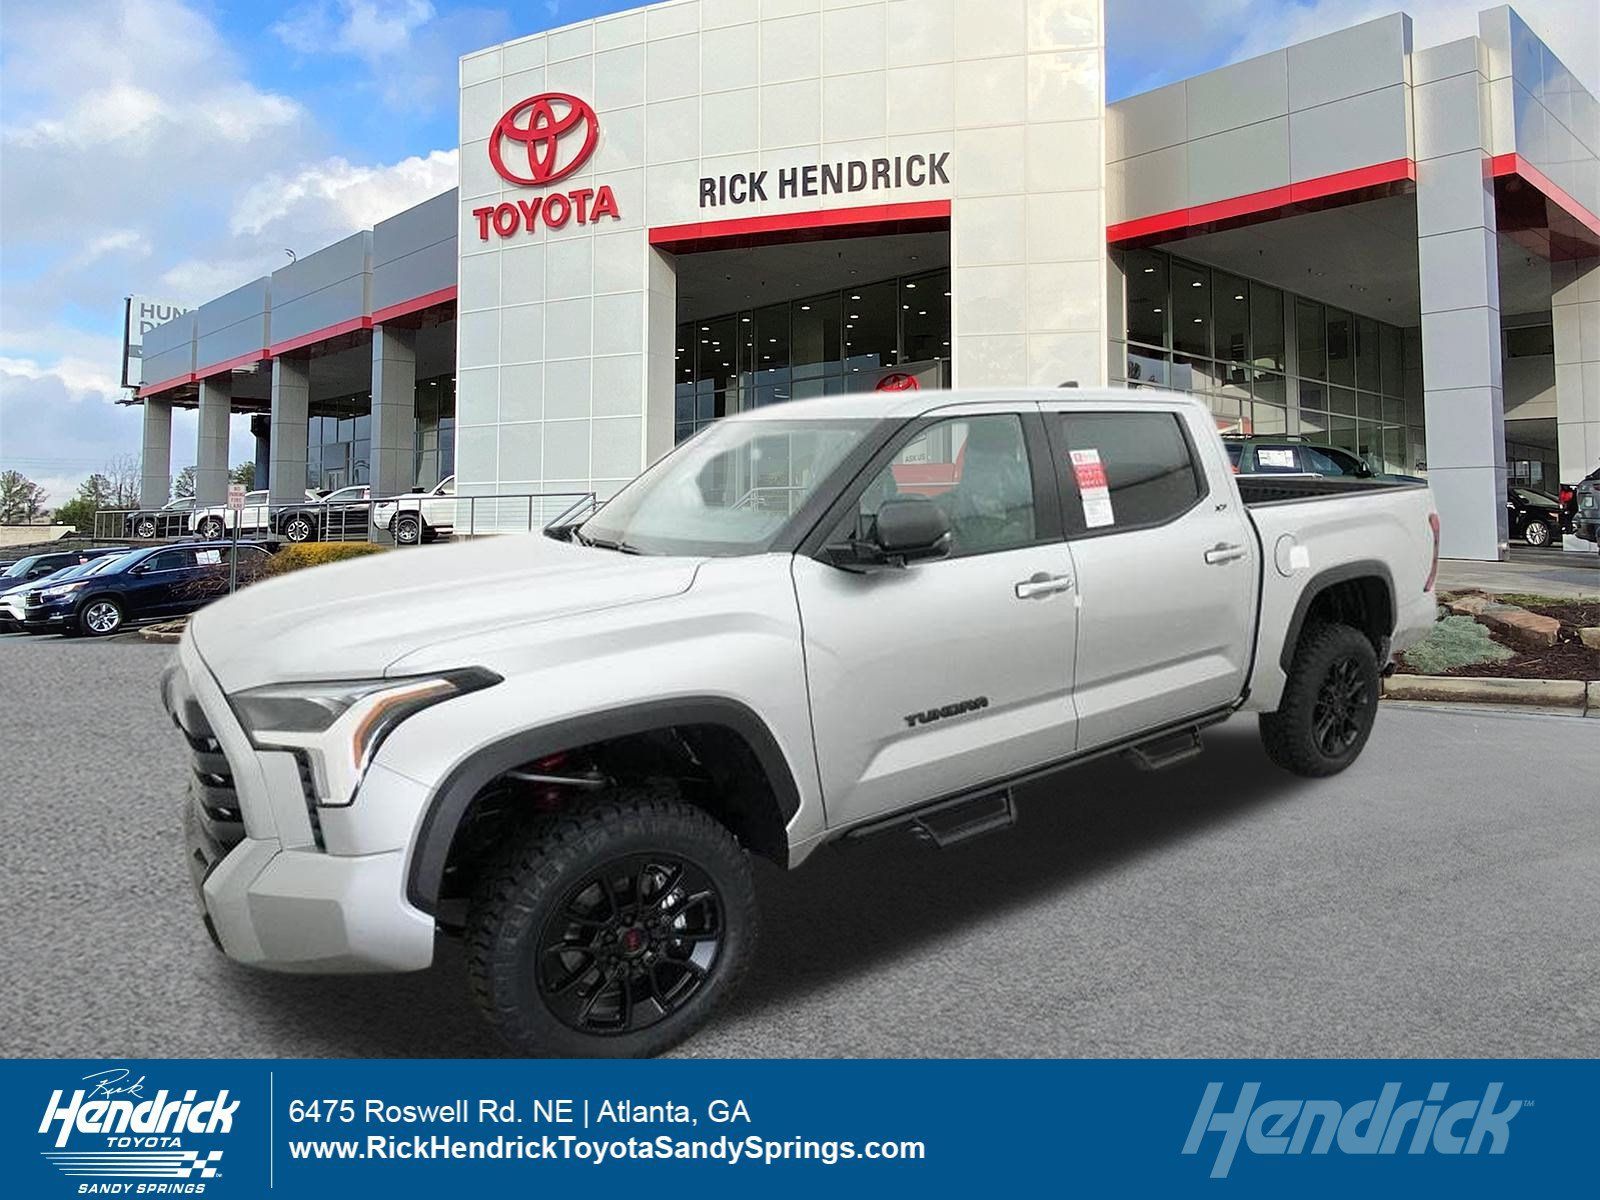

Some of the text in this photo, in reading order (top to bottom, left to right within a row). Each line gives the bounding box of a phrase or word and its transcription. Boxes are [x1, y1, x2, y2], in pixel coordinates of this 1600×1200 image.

[699, 151, 951, 208] RICK HENDRICK
[472, 185, 620, 241] TOYOTA
[904, 696, 989, 727] TUNDRA
